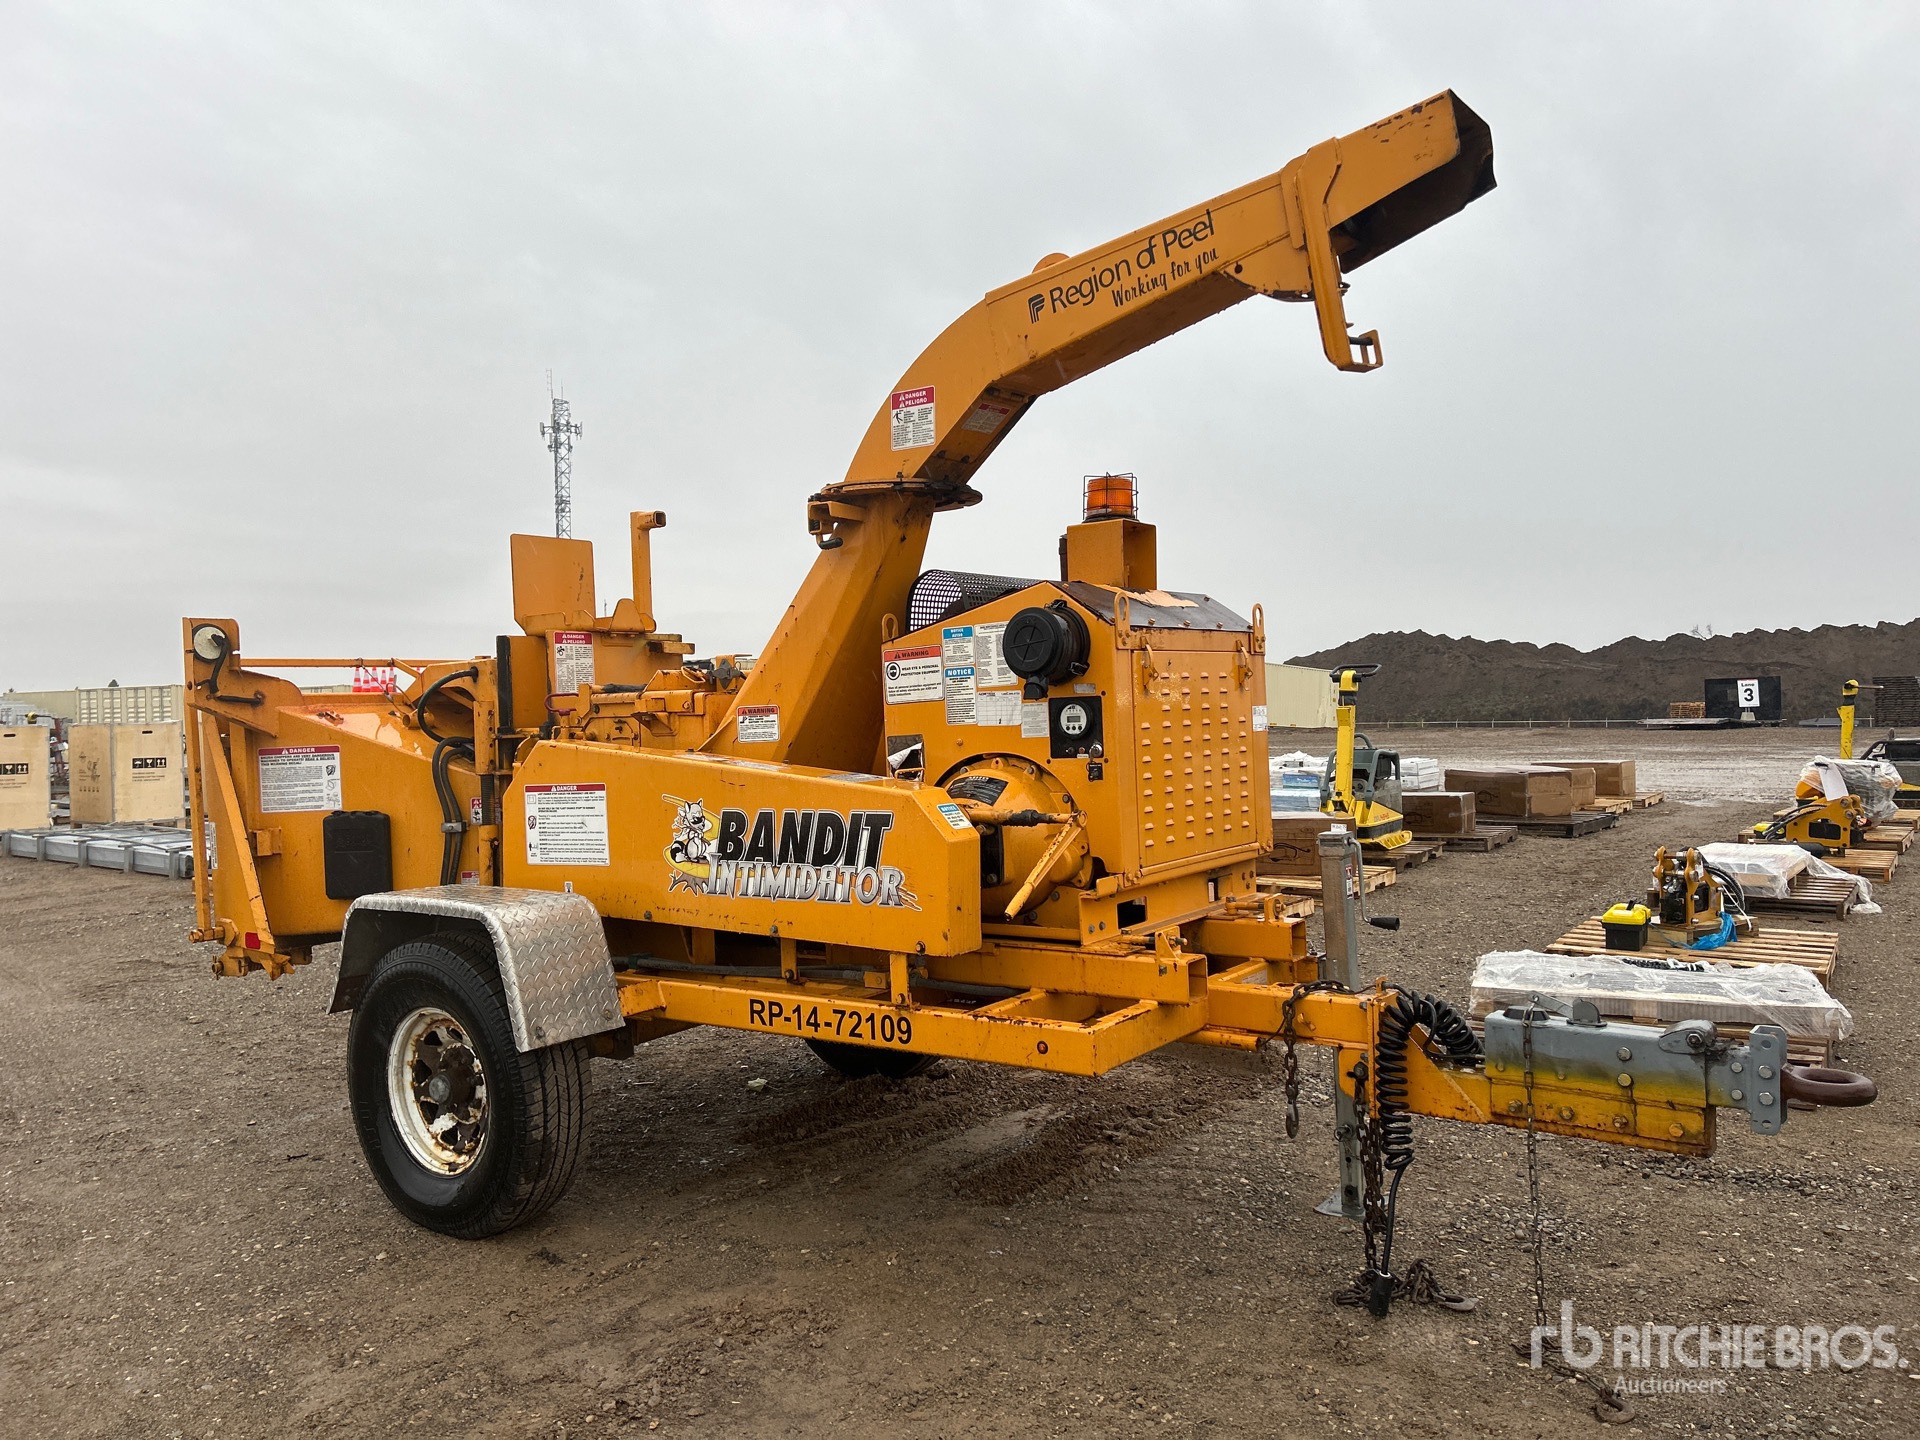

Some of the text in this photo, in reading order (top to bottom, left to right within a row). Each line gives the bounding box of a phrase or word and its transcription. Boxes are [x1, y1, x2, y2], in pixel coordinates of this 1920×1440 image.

[1049, 208, 1215, 314] Region of Peel
[1111, 248, 1220, 308] Working for you
[905, 397, 927, 406] PELIGRO
[1743, 688, 1754, 702] 3
[716, 808, 895, 871] BANDIT
[702, 852, 906, 907] INTIMIDATOR
[749, 998, 912, 1044] RP-14-72109
